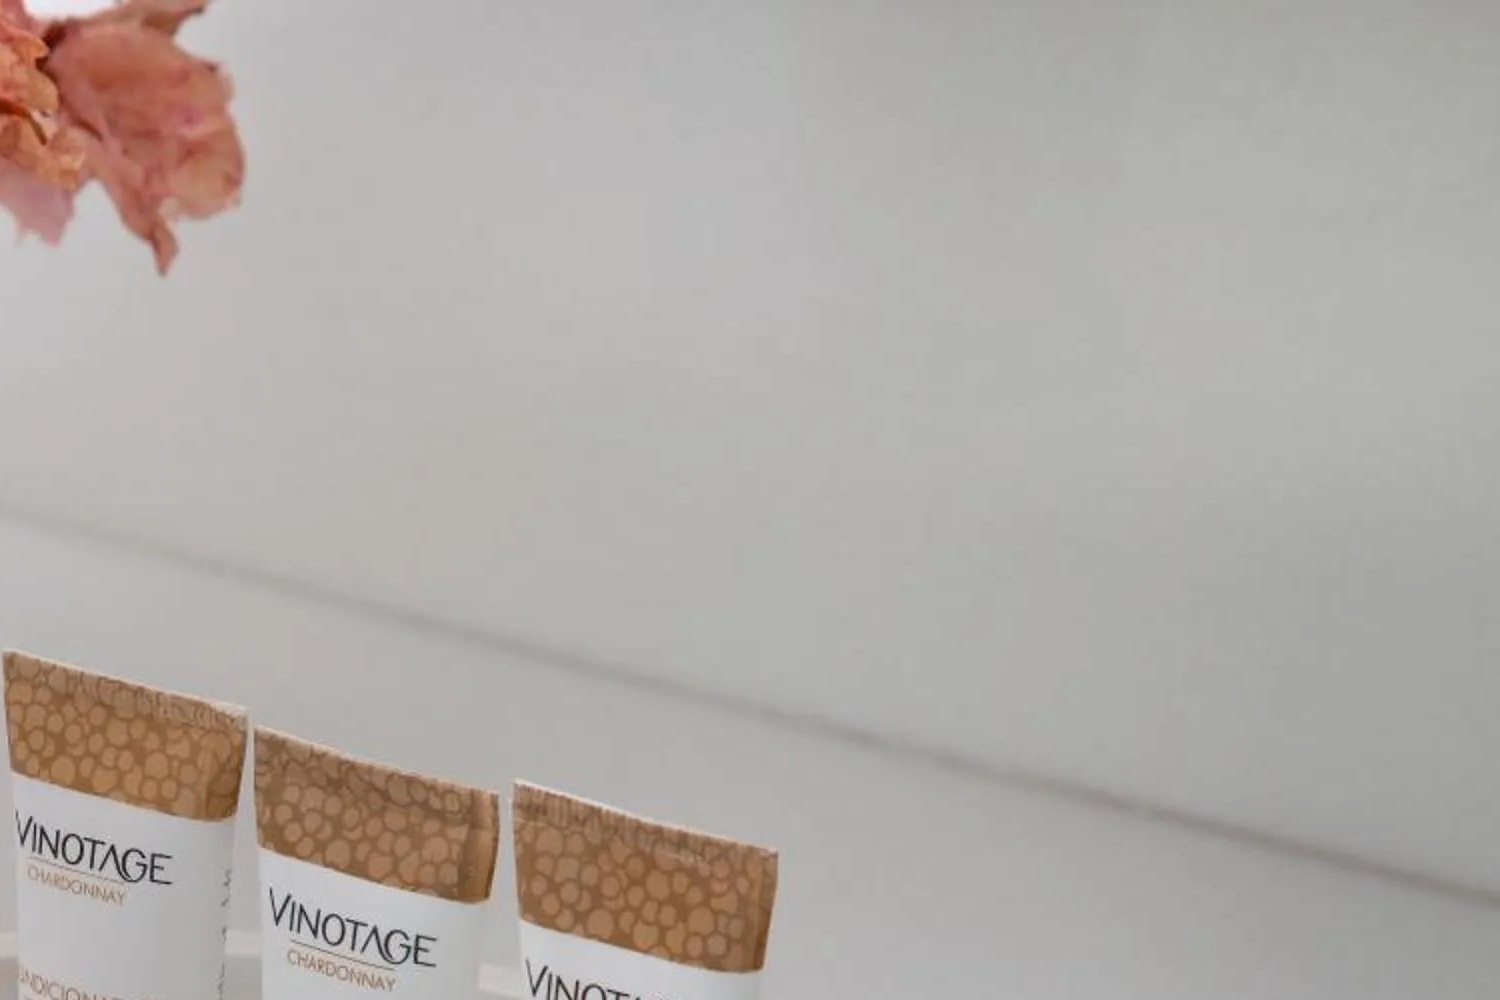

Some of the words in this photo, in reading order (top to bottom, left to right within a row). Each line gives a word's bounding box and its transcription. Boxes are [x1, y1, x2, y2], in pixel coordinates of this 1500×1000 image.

[14, 809, 173, 885] VINOTAGE
[27, 865, 125, 905] CHARDONNAY
[269, 886, 437, 967] VINOTAGE
[287, 950, 396, 992] CHARDONNAY
